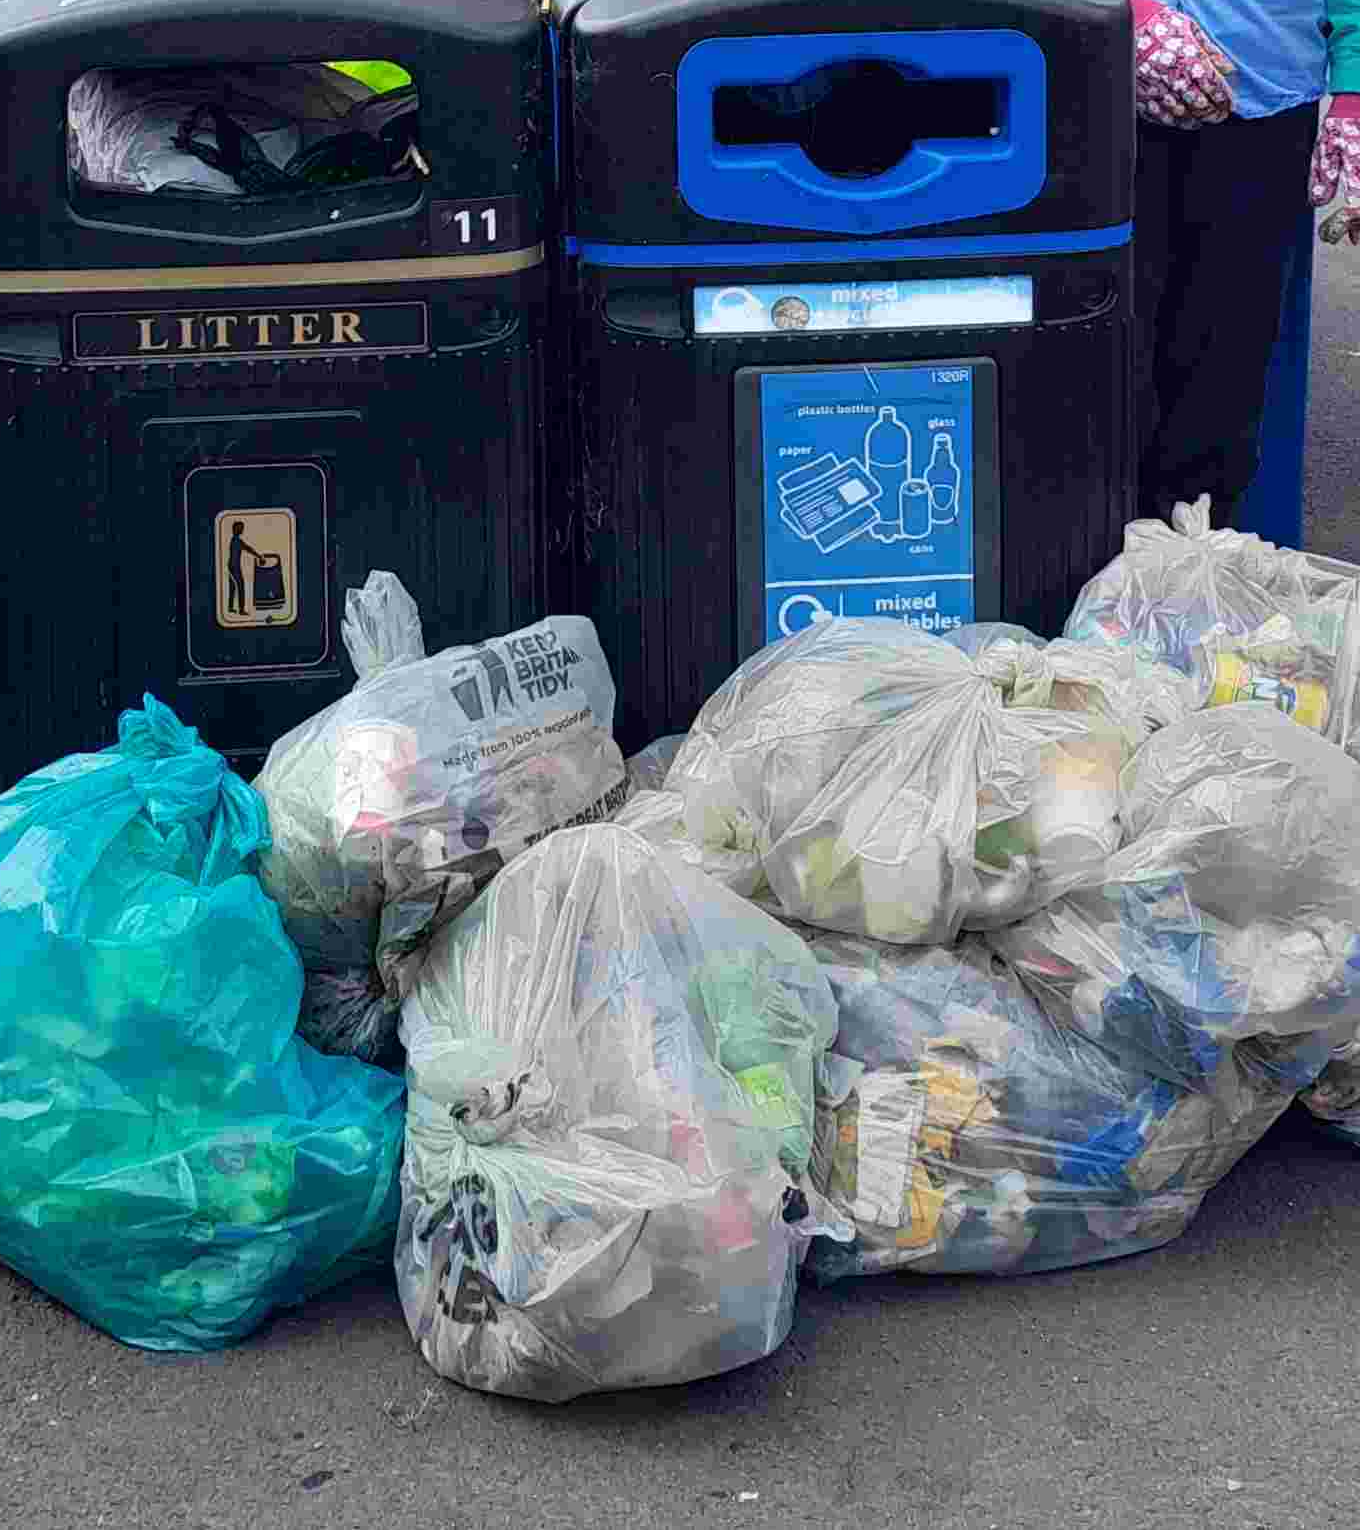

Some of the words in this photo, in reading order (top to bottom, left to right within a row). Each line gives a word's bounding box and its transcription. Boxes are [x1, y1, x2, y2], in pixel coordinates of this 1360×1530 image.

[453, 208, 497, 244] 11
[136, 311, 366, 351] LITTER
[797, 405, 834, 418] plastic
[927, 415, 956, 430] glass
[778, 444, 813, 458] paper
[874, 590, 937, 612] mixed
[481, 739, 509, 758] from
[511, 727, 542, 750] 100%
